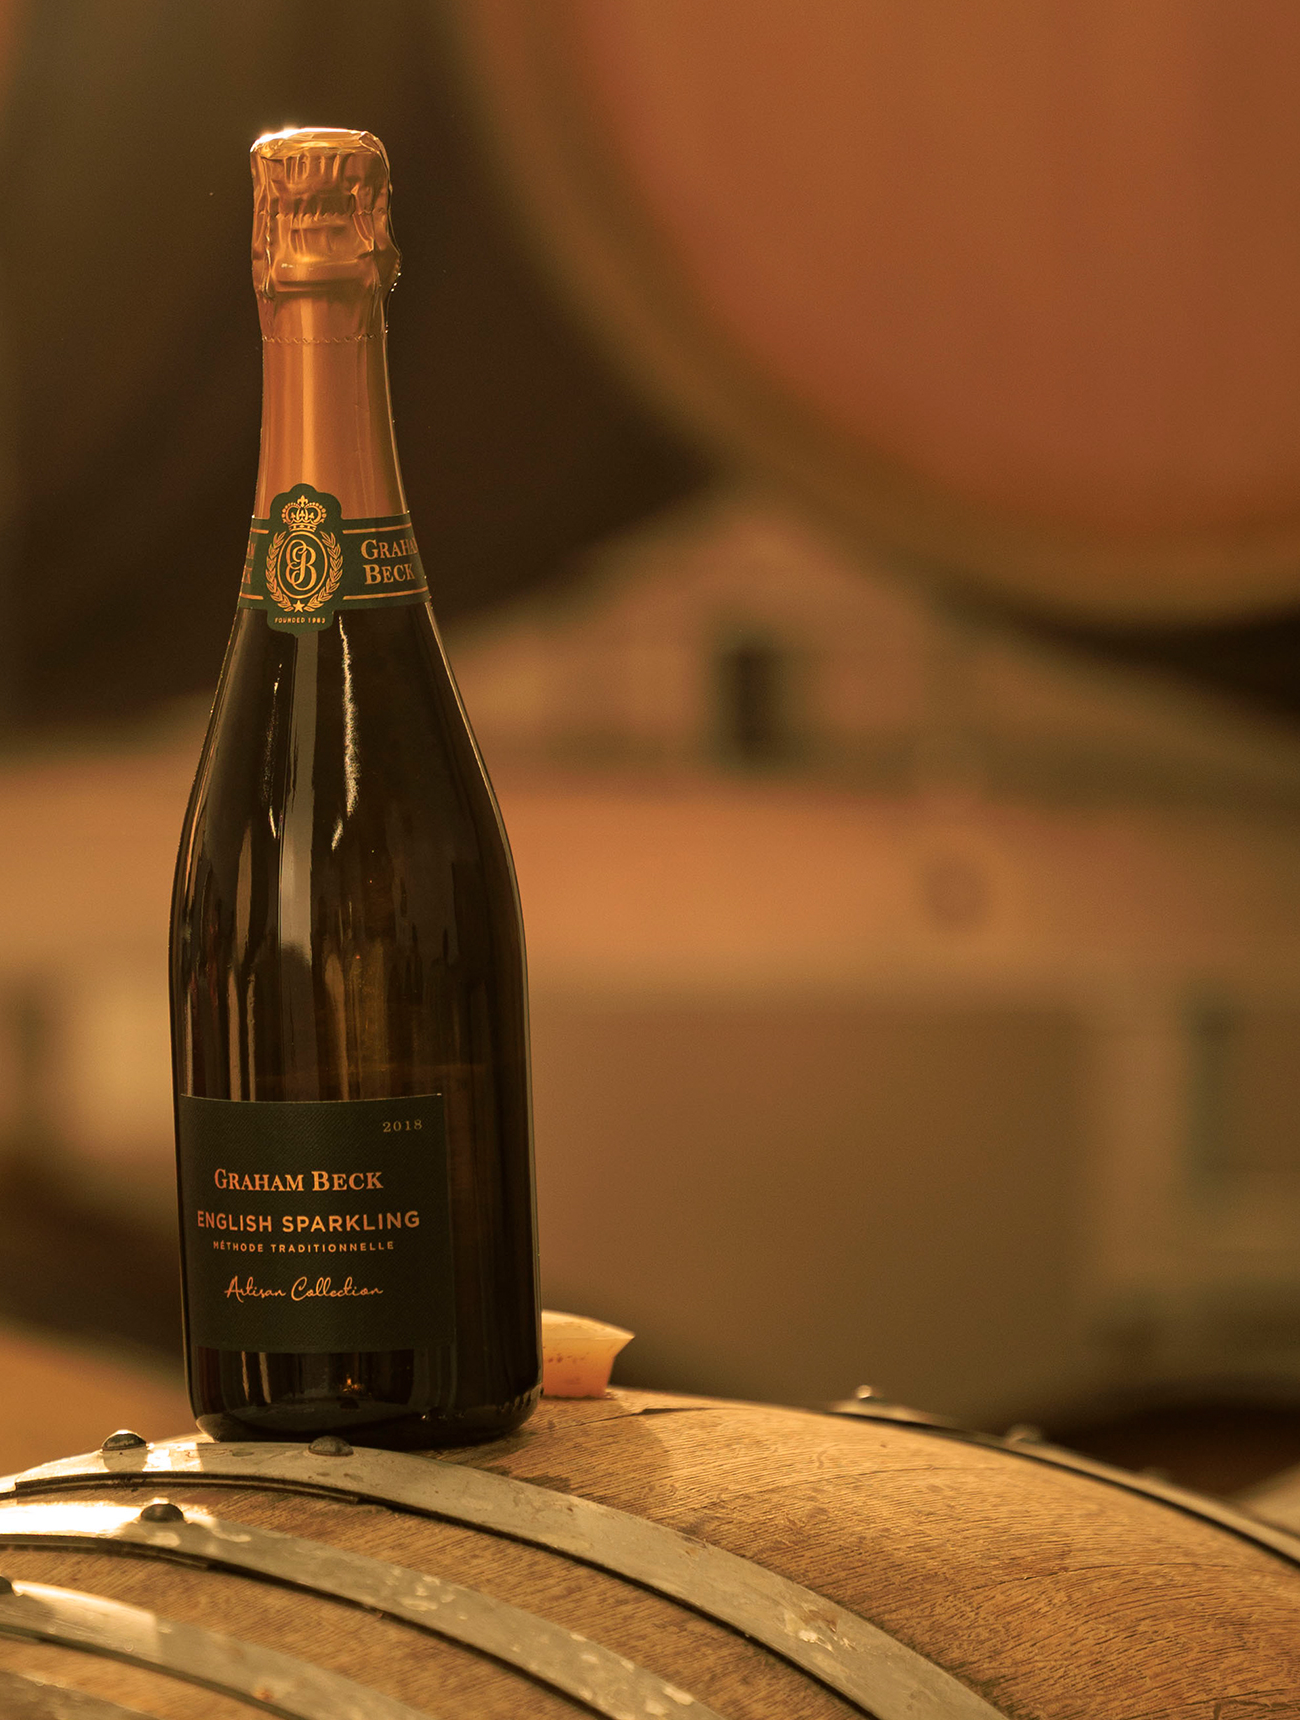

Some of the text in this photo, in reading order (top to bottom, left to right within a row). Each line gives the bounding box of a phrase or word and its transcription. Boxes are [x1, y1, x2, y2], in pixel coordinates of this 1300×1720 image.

[362, 563, 416, 585] BECK
[382, 1119, 423, 1133] 2018
[214, 1168, 384, 1192] GRAHAM BECK
[197, 1210, 420, 1233] ENGLISH SPARKLING
[212, 1239, 394, 1254] MÉTHODE TRADITIONNELLE
[224, 1275, 384, 1304] Artisan Collection
